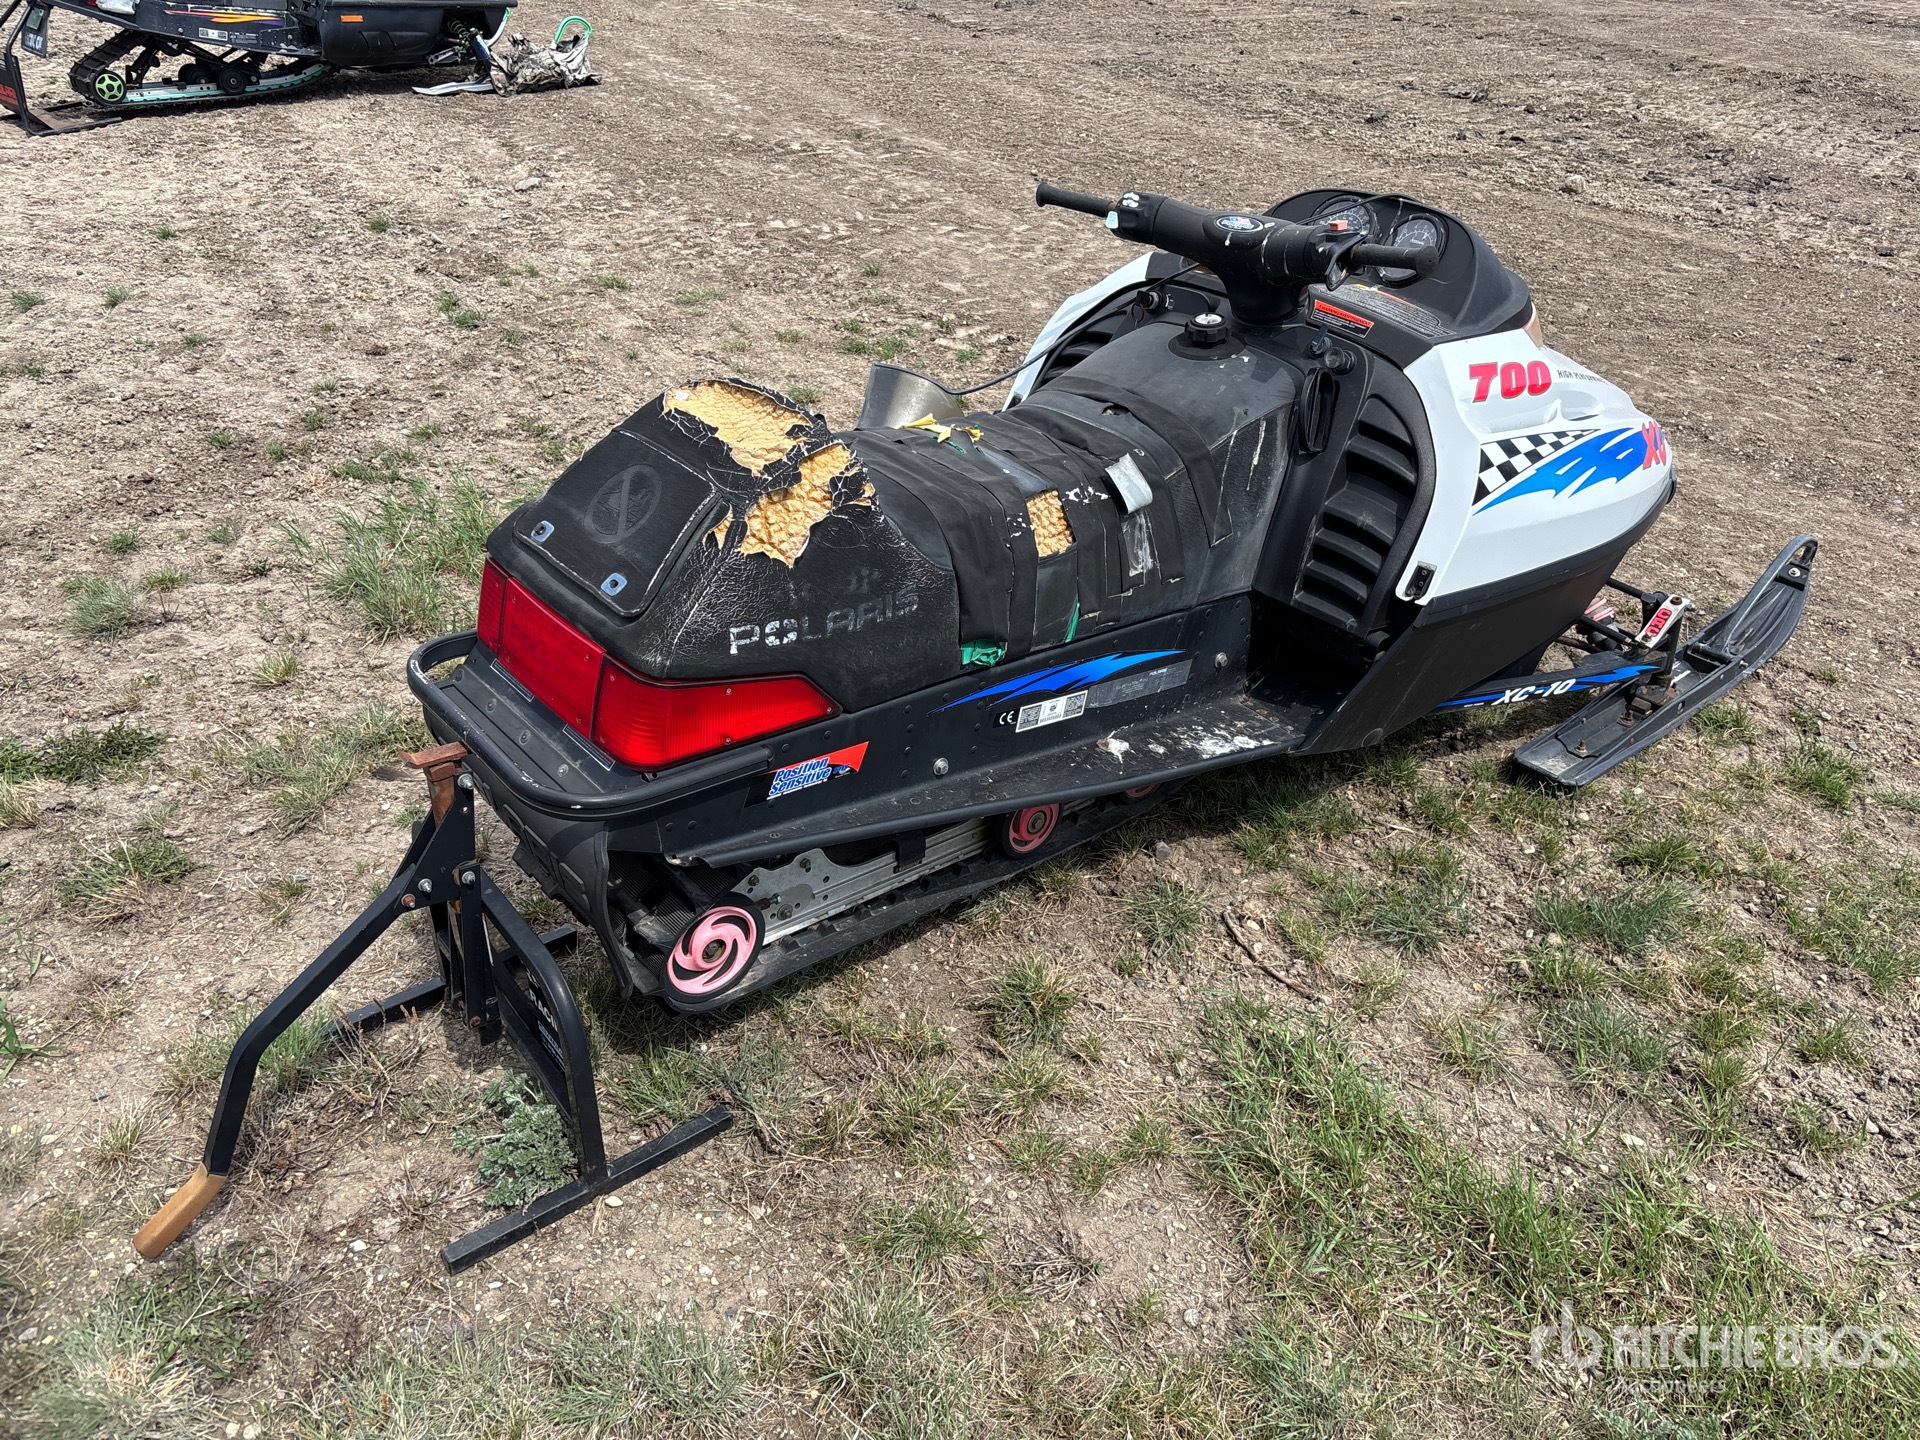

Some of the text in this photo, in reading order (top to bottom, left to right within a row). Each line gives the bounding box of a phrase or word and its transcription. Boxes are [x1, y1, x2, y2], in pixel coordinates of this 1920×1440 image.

[1469, 360, 1552, 403] 700
[1557, 369, 1574, 379] HIGH
[729, 583, 919, 655] POLARIS
[1491, 678, 1577, 706] XC-10
[769, 767, 832, 795] Sensitive
[774, 757, 830, 783] Position
